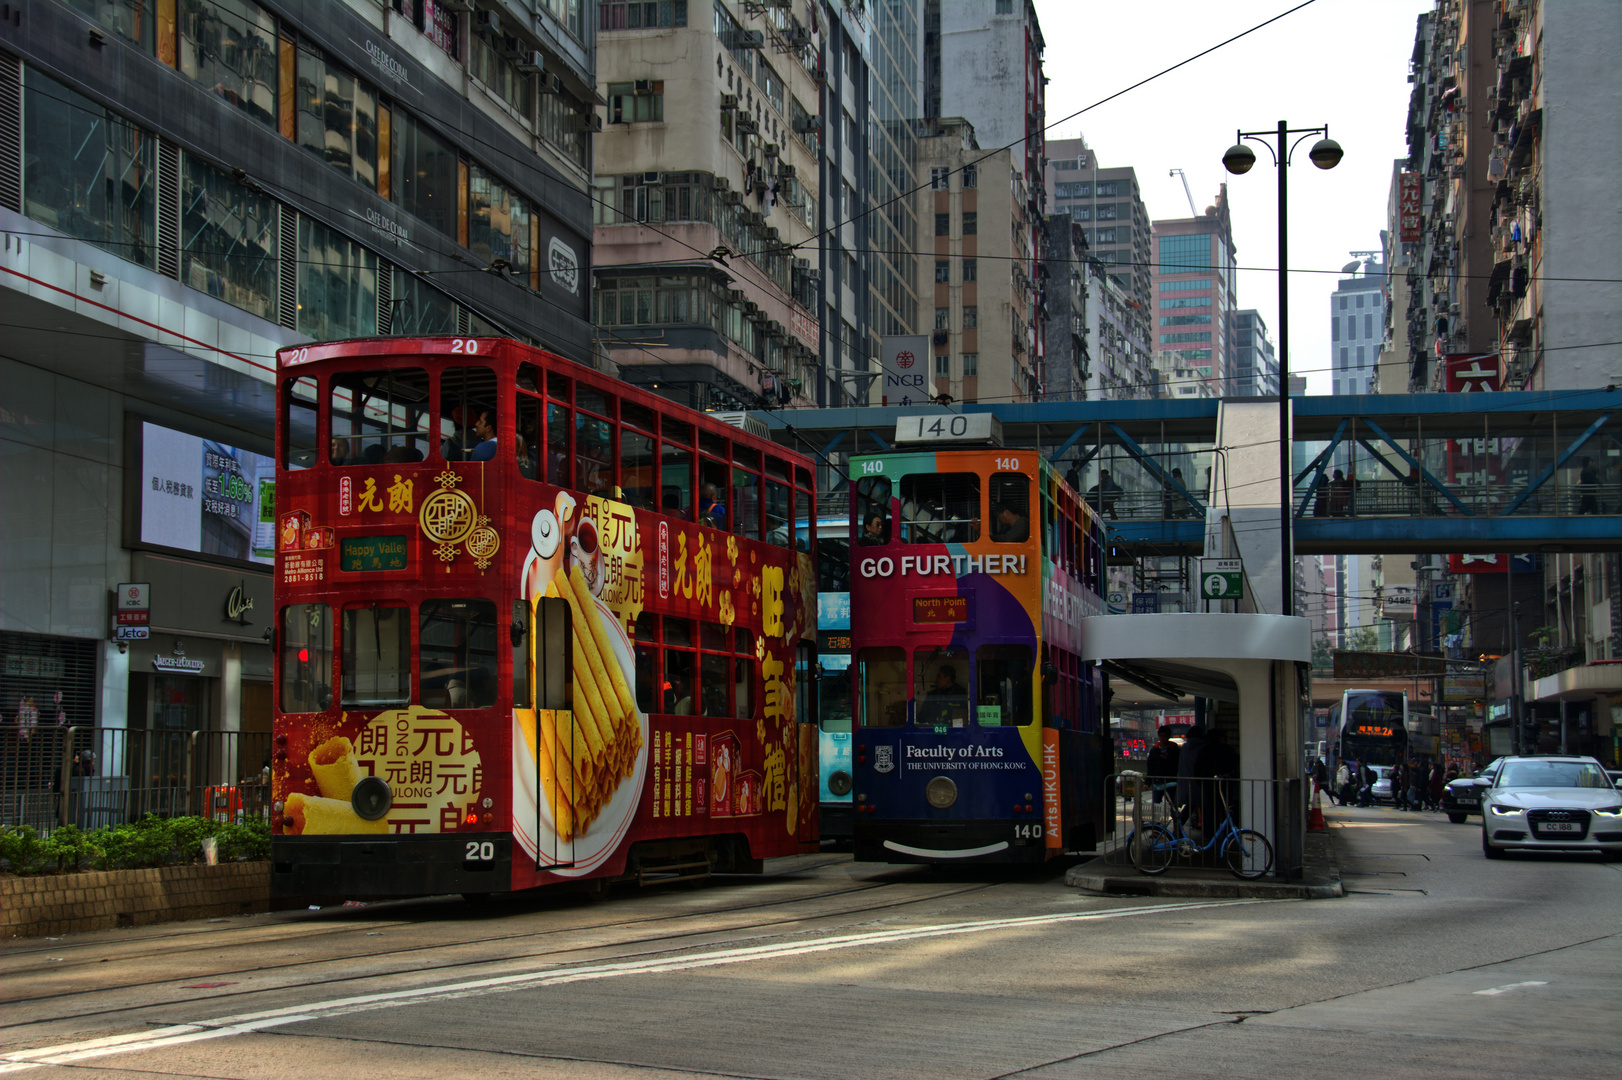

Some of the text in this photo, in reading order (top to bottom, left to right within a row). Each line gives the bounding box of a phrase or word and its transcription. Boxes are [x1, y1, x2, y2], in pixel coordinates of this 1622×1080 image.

[365, 39, 381, 60] CAFE
[380, 50, 389, 66] DE
[366, 207, 381, 226] CAFE
[381, 215, 390, 231] DE
[451, 339, 479, 354] 20
[289, 347, 308, 365] 20
[887, 374, 924, 387] NCB
[918, 416, 967, 437] 140
[861, 460, 883, 474] 140
[994, 457, 1019, 471] 140
[357, 474, 414, 514] 元朗
[344, 542, 407, 557] Happy Valley
[351, 557, 402, 570] 跑馬地
[860, 554, 1026, 577] GO FURTHER!
[284, 573, 323, 583] 2881-8518
[915, 597, 966, 607] North Point
[927, 608, 956, 618] 北角
[934, 725, 947, 734] 046
[1382, 726, 1394, 737] 2A
[906, 745, 1004, 760] Faculty of Arts
[385, 760, 432, 785] 元朗
[907, 762, 922, 770] THE
[923, 762, 968, 770] UNIVERSITY
[1004, 761, 1027, 769] KONG
[1043, 743, 1059, 837] Arts.HKU.HK
[1014, 824, 1042, 839] 140
[1546, 823, 1573, 831] CC 188
[465, 841, 495, 861] 20
